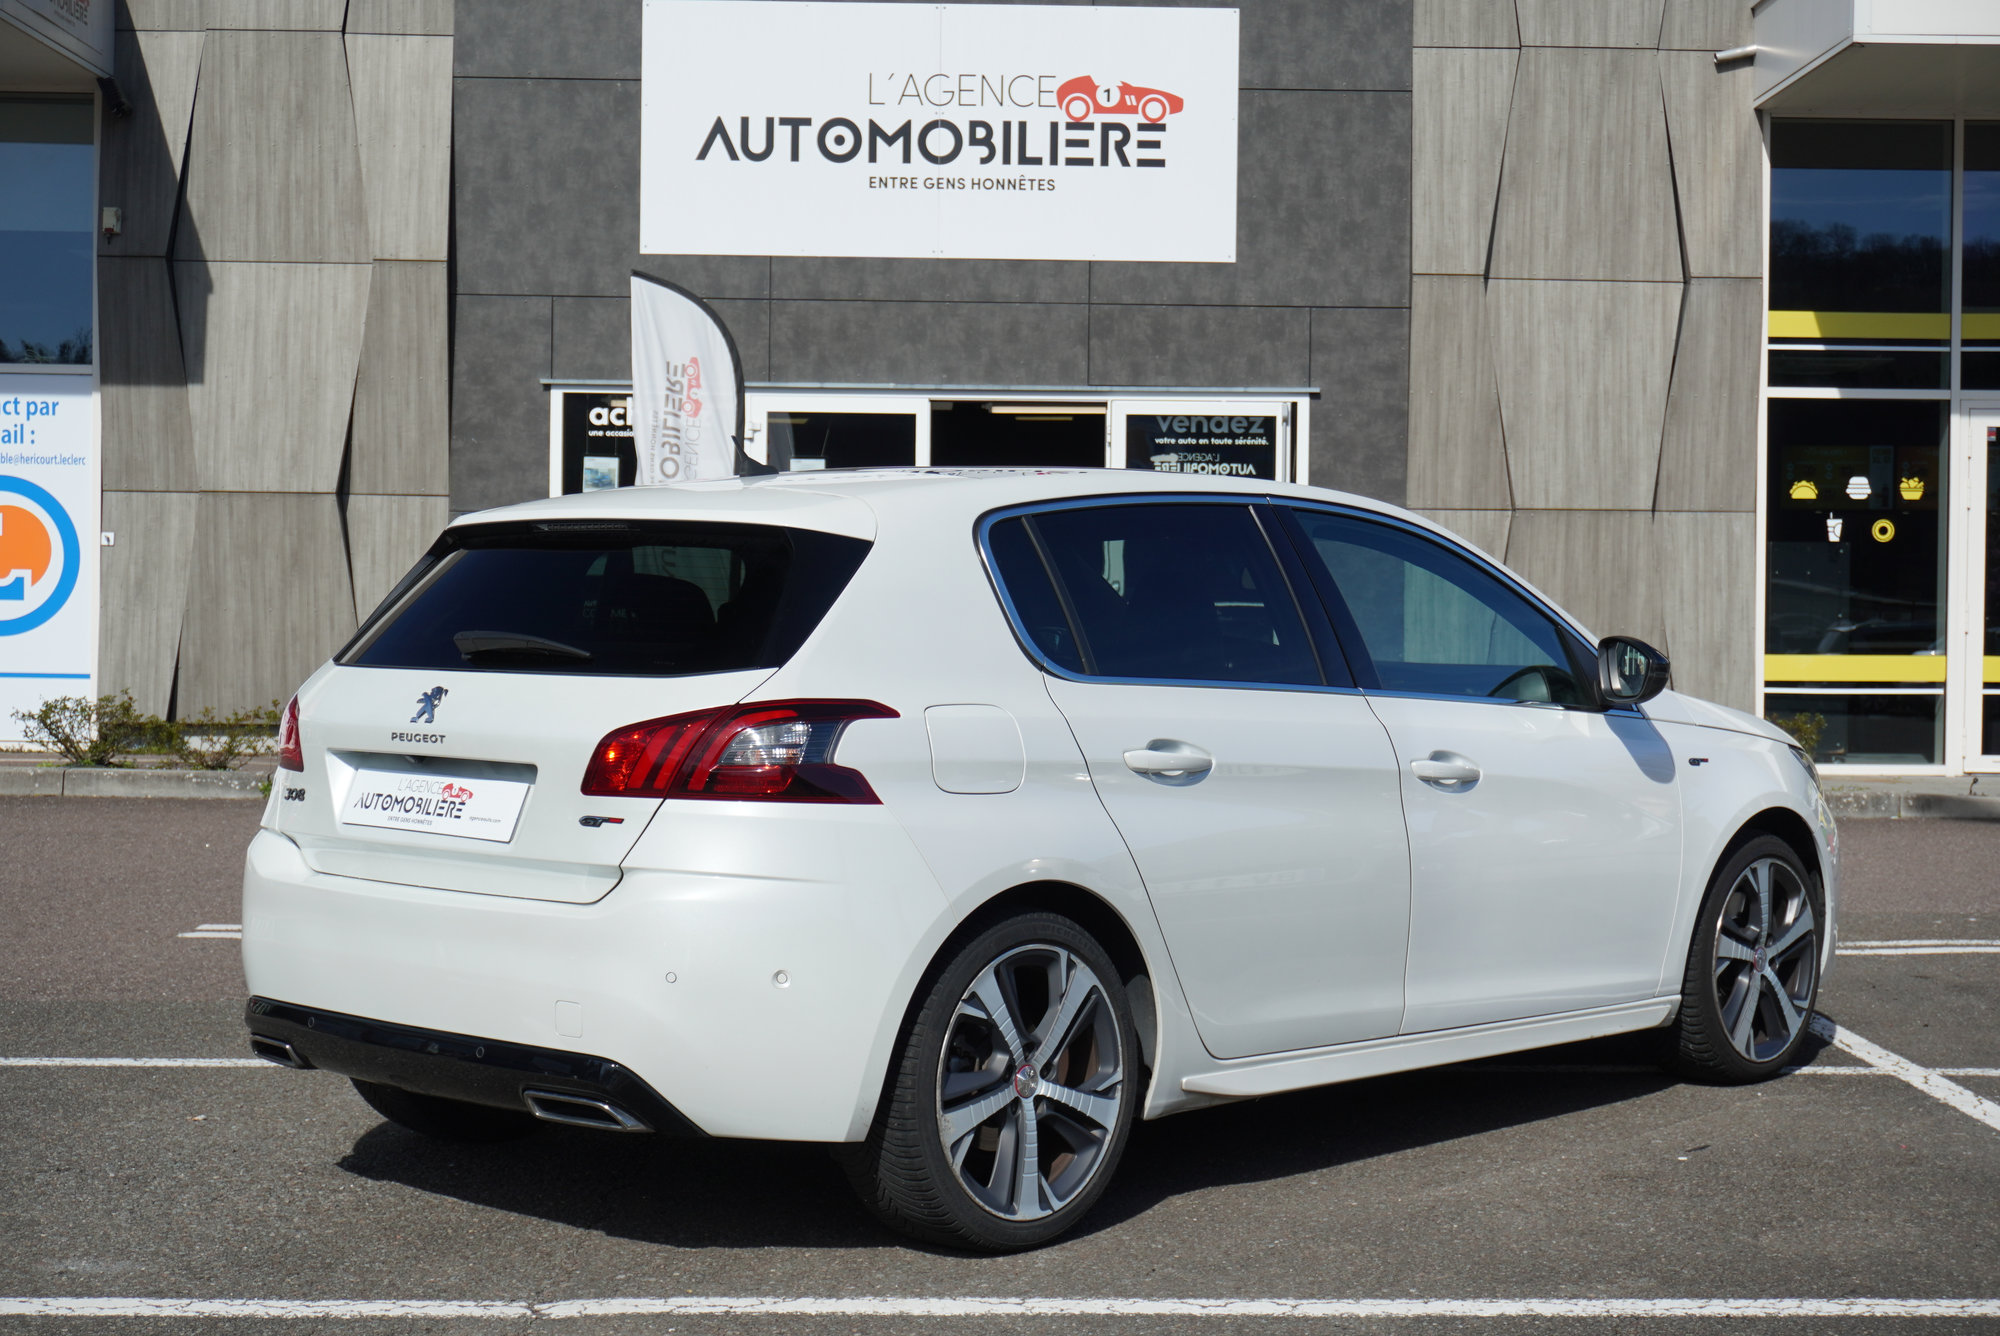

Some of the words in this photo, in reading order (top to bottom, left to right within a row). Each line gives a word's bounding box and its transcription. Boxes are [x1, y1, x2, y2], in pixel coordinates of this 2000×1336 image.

[869, 176, 918, 190] ENTRE
[923, 177, 966, 191] GENS
[971, 174, 1056, 192] HONNÊTES
[0, 397, 20, 415] ct
[26, 401, 59, 421] par
[1154, 437, 1176, 445] votre
[1178, 437, 1197, 445] auto
[1211, 437, 1232, 445] toute
[391, 732, 446, 744] PEUGEOT
[284, 788, 306, 802] 308
